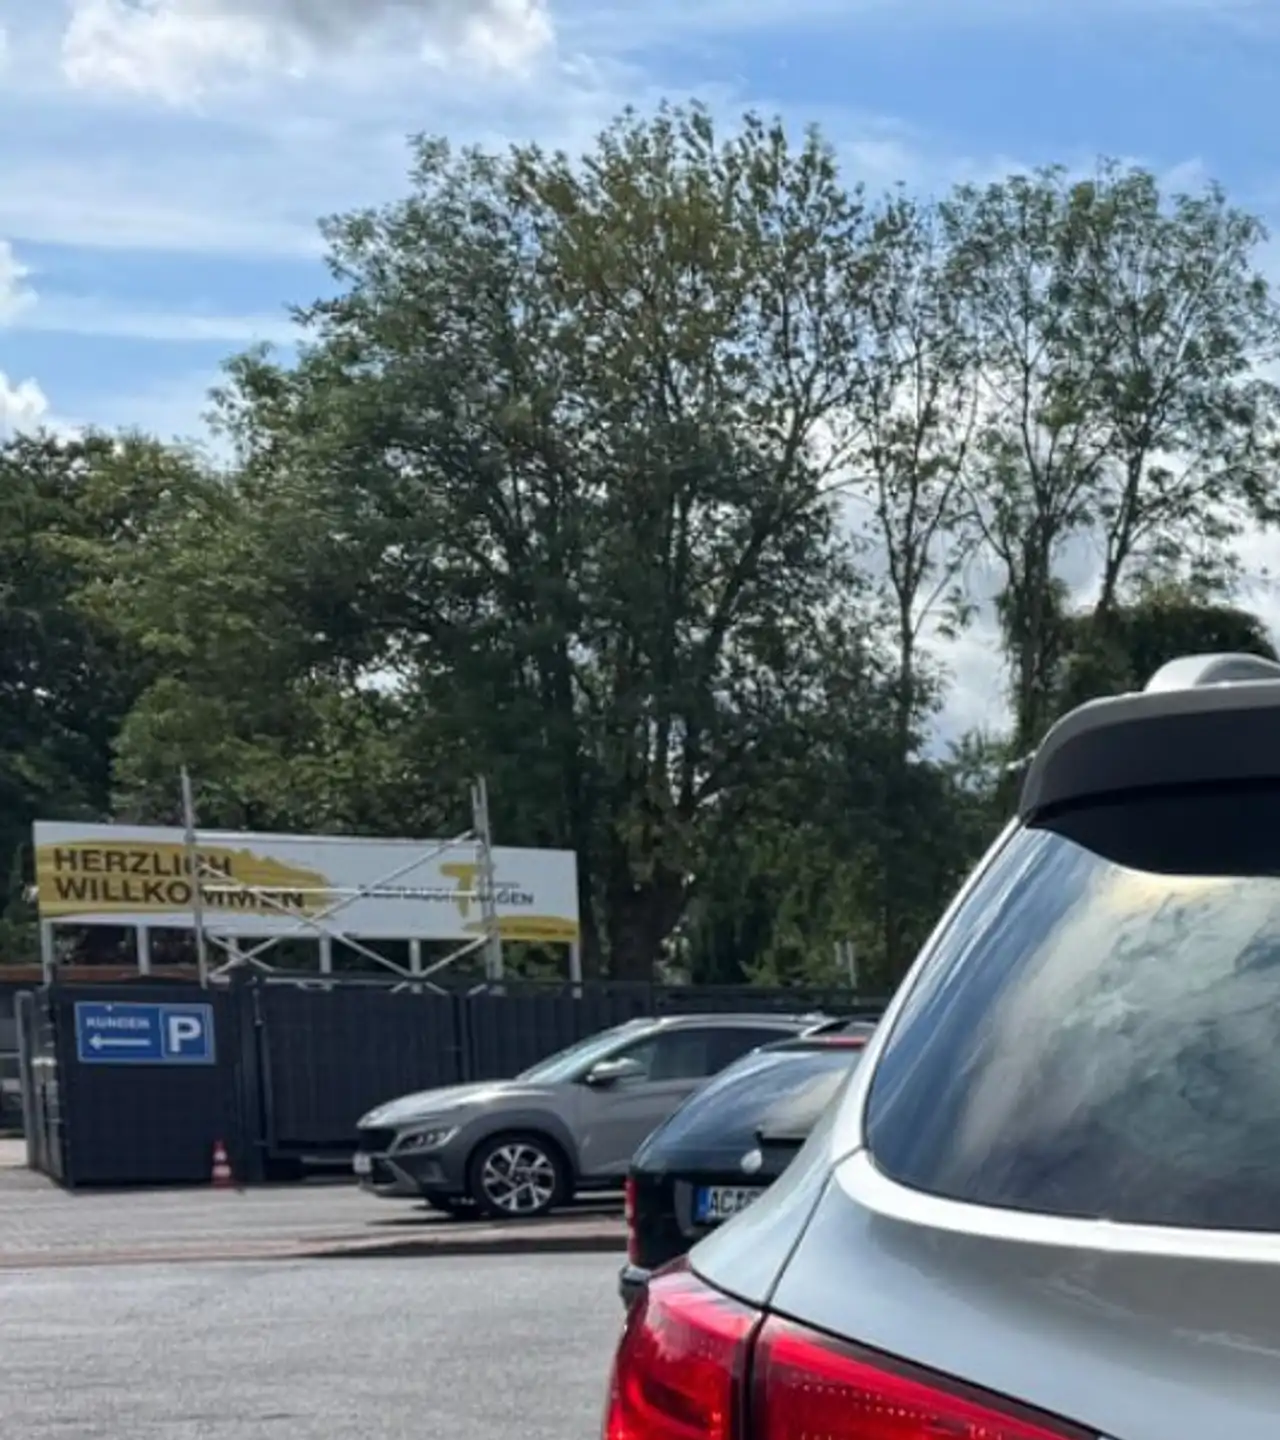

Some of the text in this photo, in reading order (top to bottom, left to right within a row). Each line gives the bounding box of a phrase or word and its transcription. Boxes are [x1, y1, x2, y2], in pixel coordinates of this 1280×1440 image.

[54, 848, 232, 877] HERZLICH
[54, 877, 305, 909] WILLKOMMEN
[86, 1016, 201, 1052] KUNDEN P
